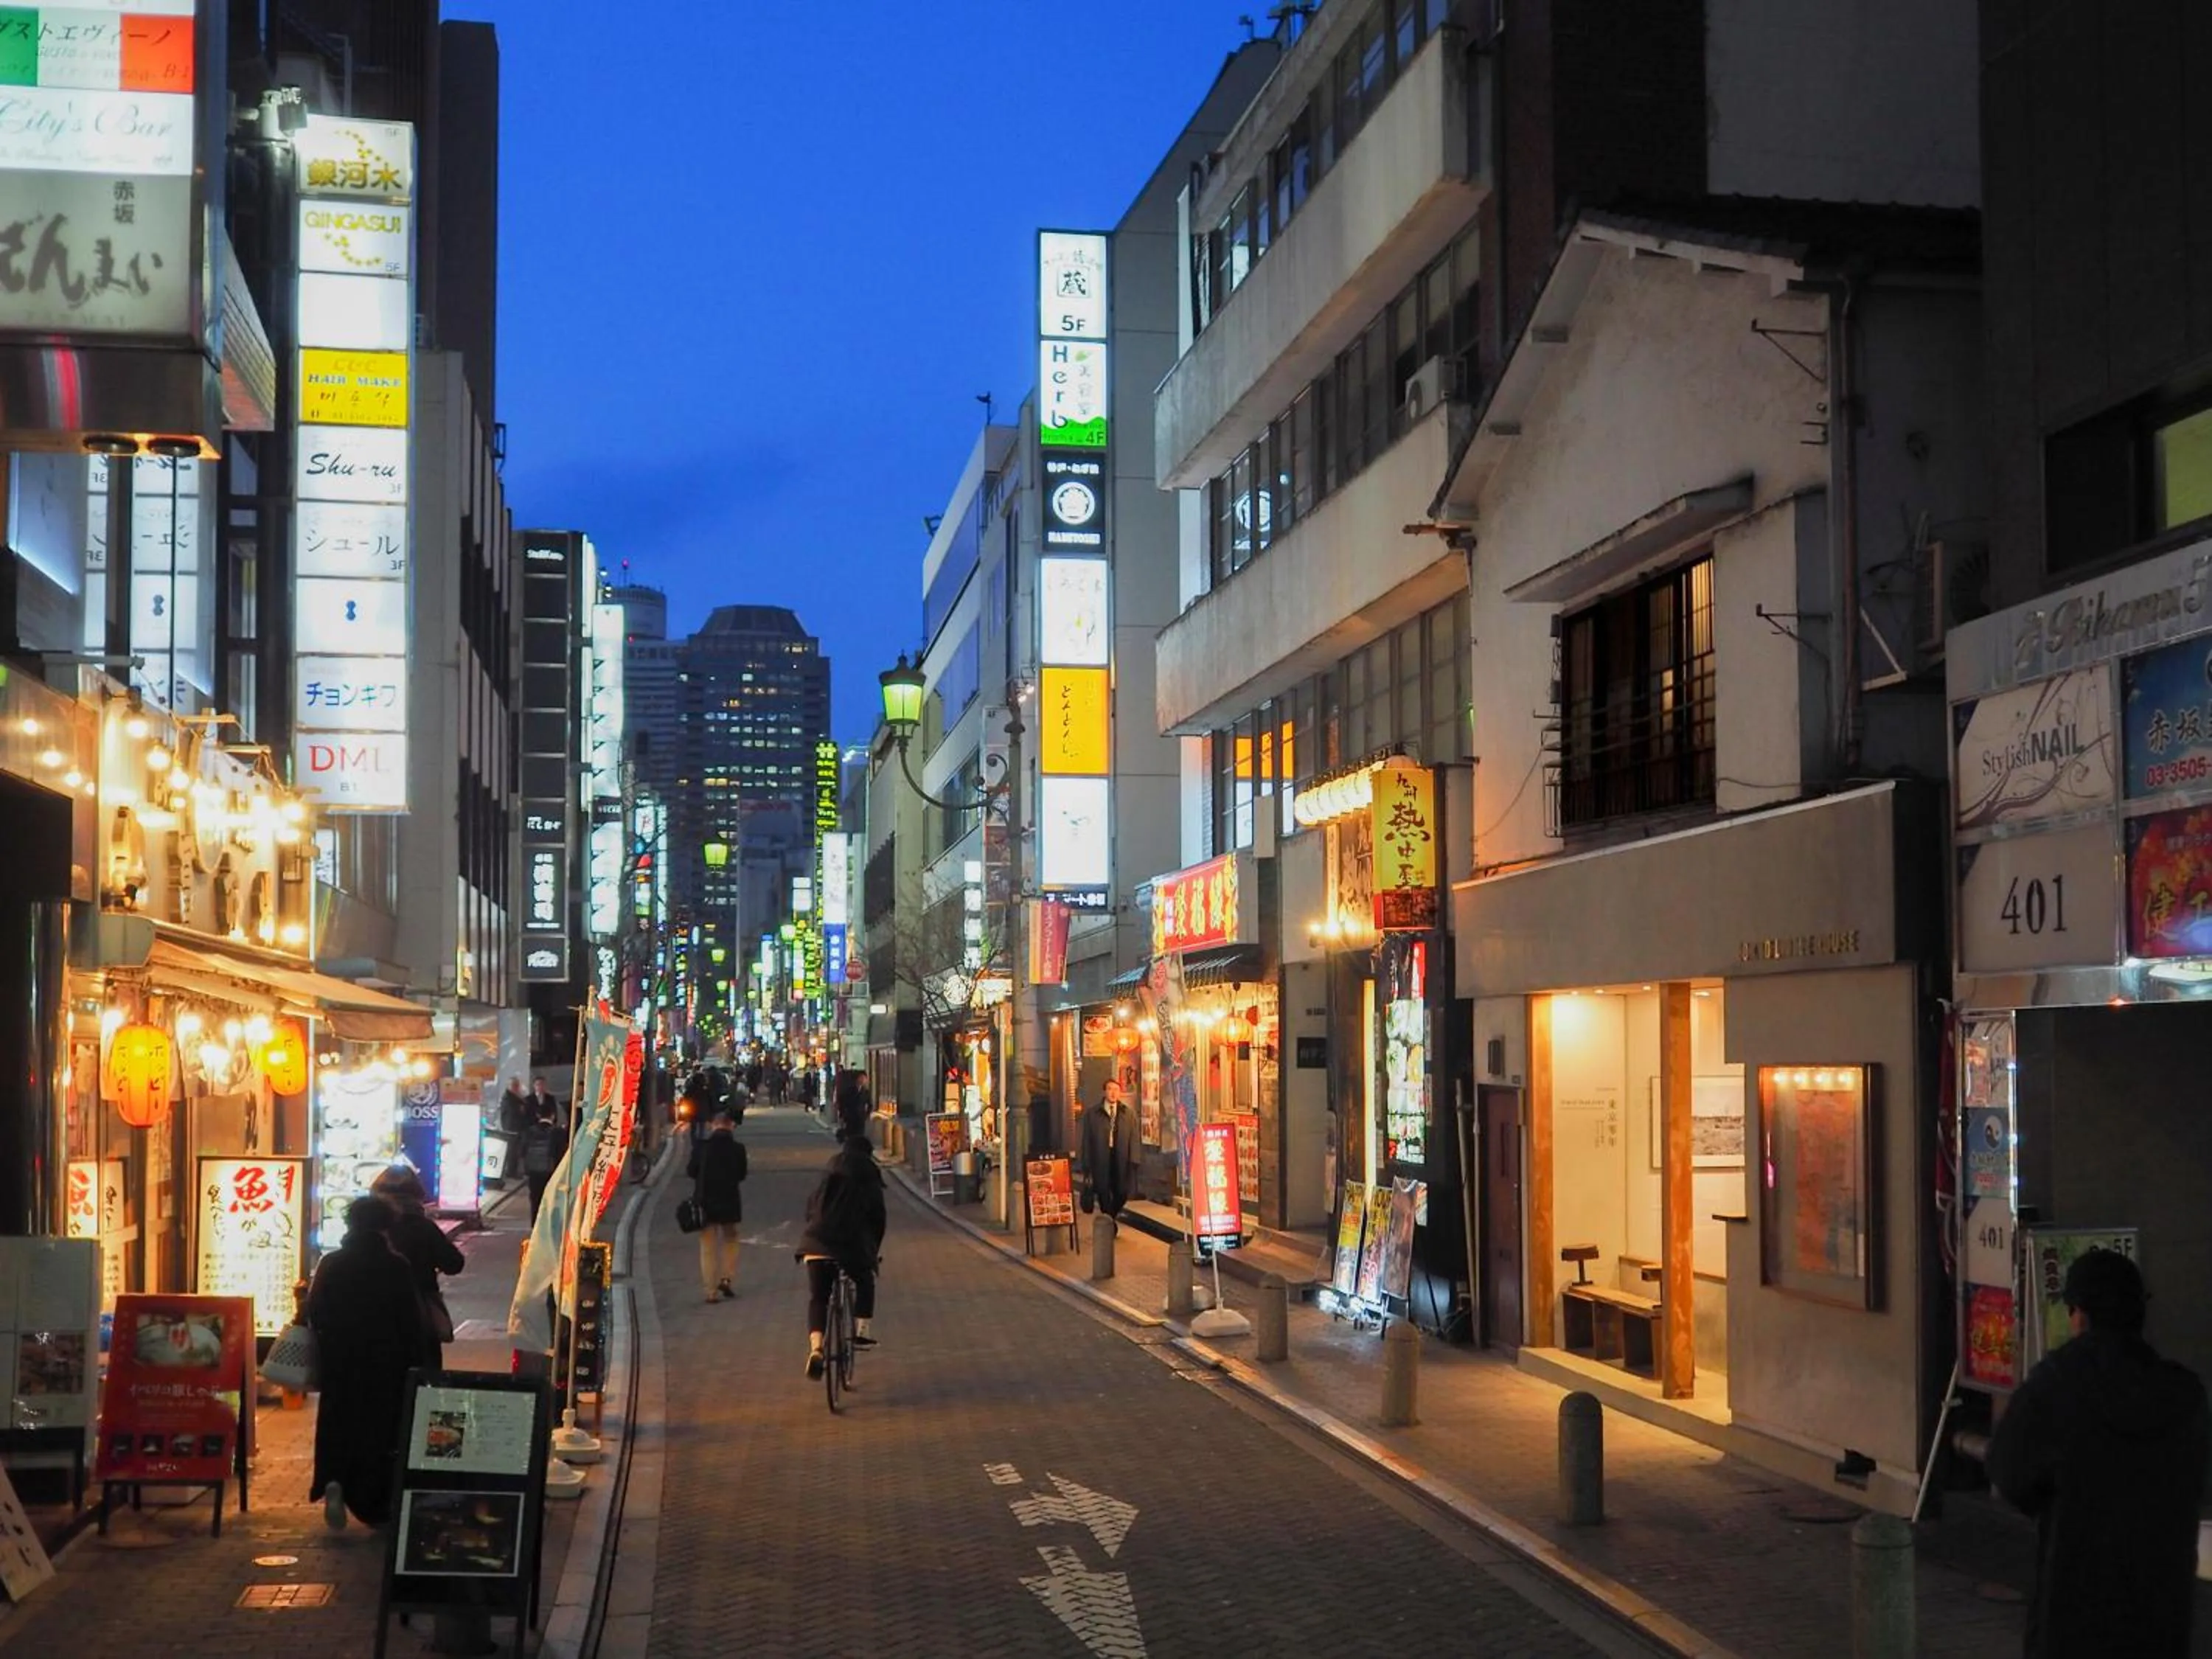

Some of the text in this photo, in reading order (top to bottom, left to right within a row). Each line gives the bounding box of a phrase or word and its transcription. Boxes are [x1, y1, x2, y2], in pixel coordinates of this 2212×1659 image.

[114, 181, 135, 224] 赤坂
[305, 210, 402, 234] GINGASUI
[1062, 315, 1086, 332] 5F
[1052, 345, 1068, 428] Herb
[1085, 431, 1104, 444] 4F
[390, 560, 405, 570] 3F
[2001, 874, 2067, 936] 401
[1978, 1225, 2004, 1251] 401
